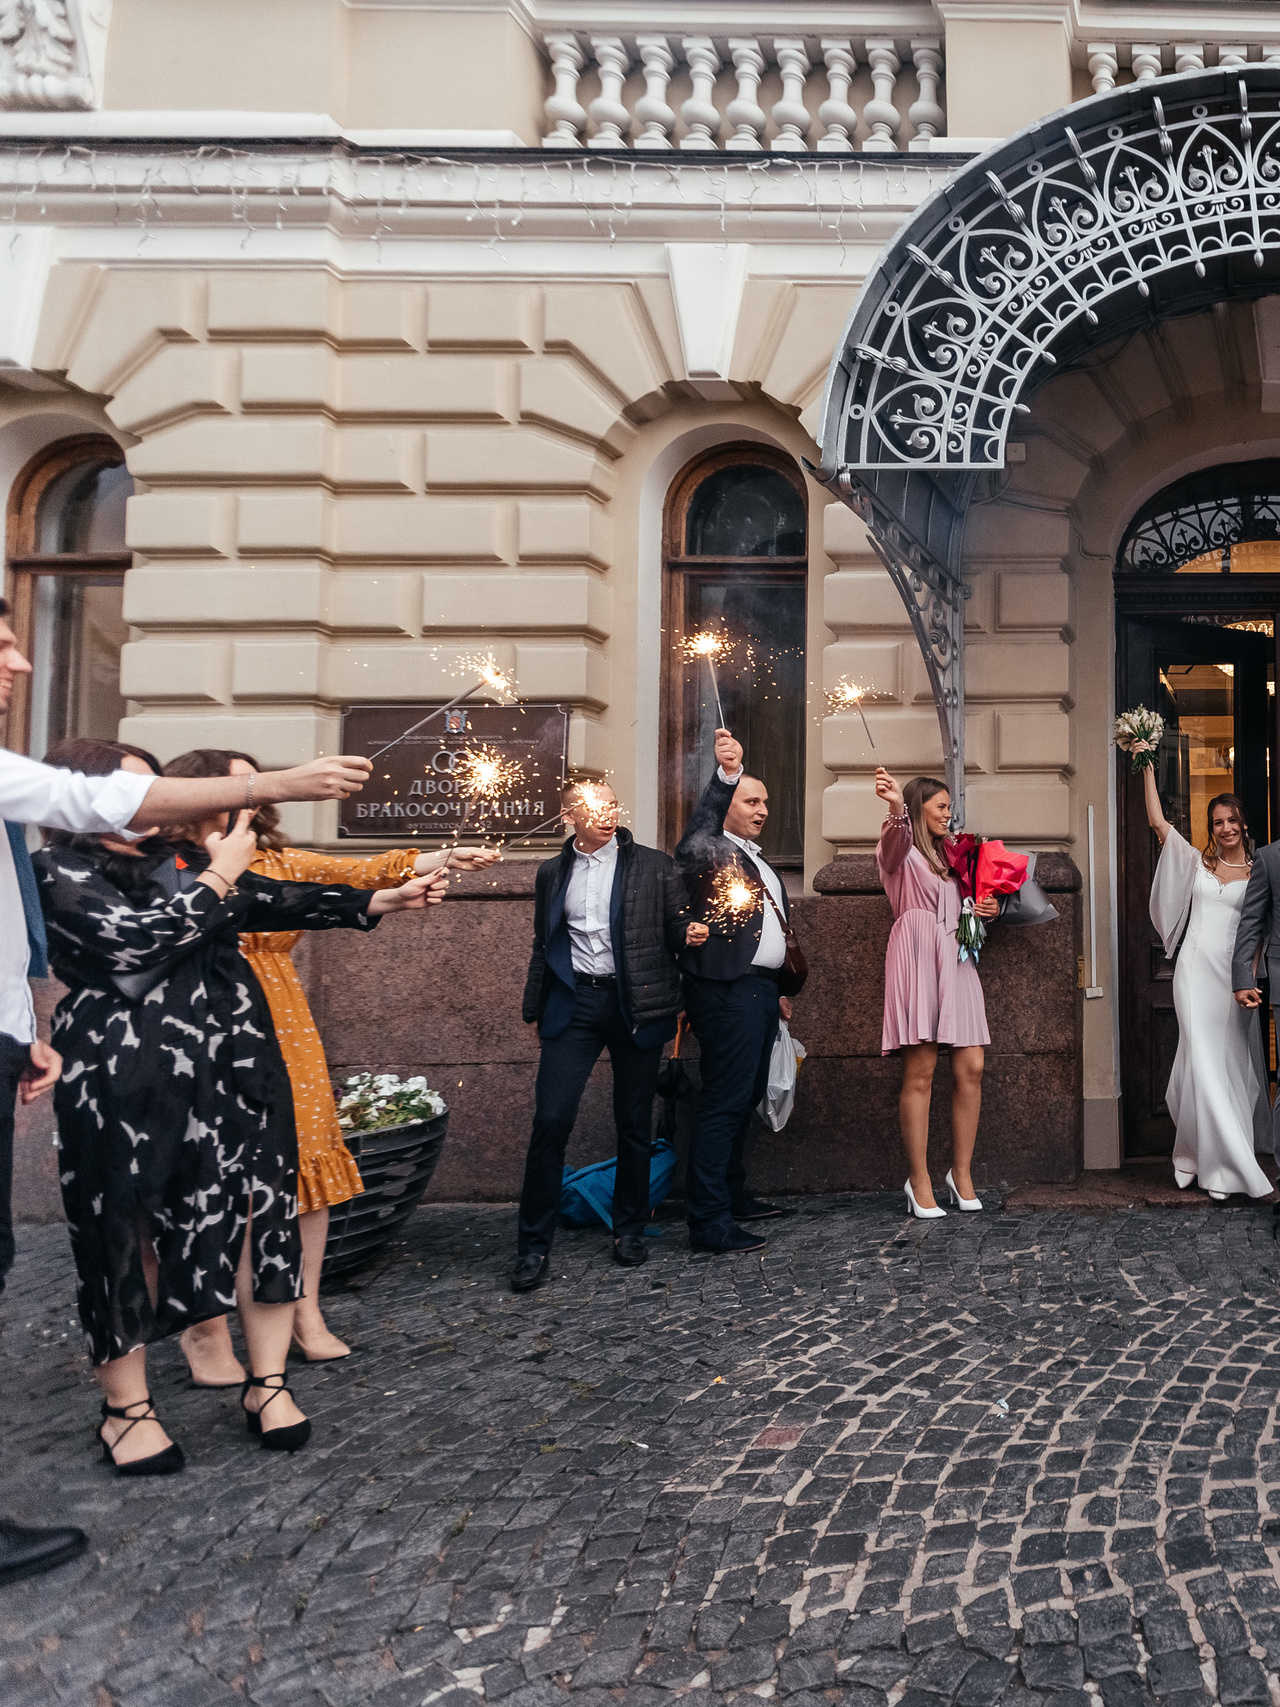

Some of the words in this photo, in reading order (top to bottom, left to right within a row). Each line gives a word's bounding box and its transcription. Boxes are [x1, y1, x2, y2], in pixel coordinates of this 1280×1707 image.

[407, 779, 490, 797] ДВОР
[355, 800, 546, 819] БРАКОСОЧЕТАНИЯ
[480, 820, 492, 829] 52
